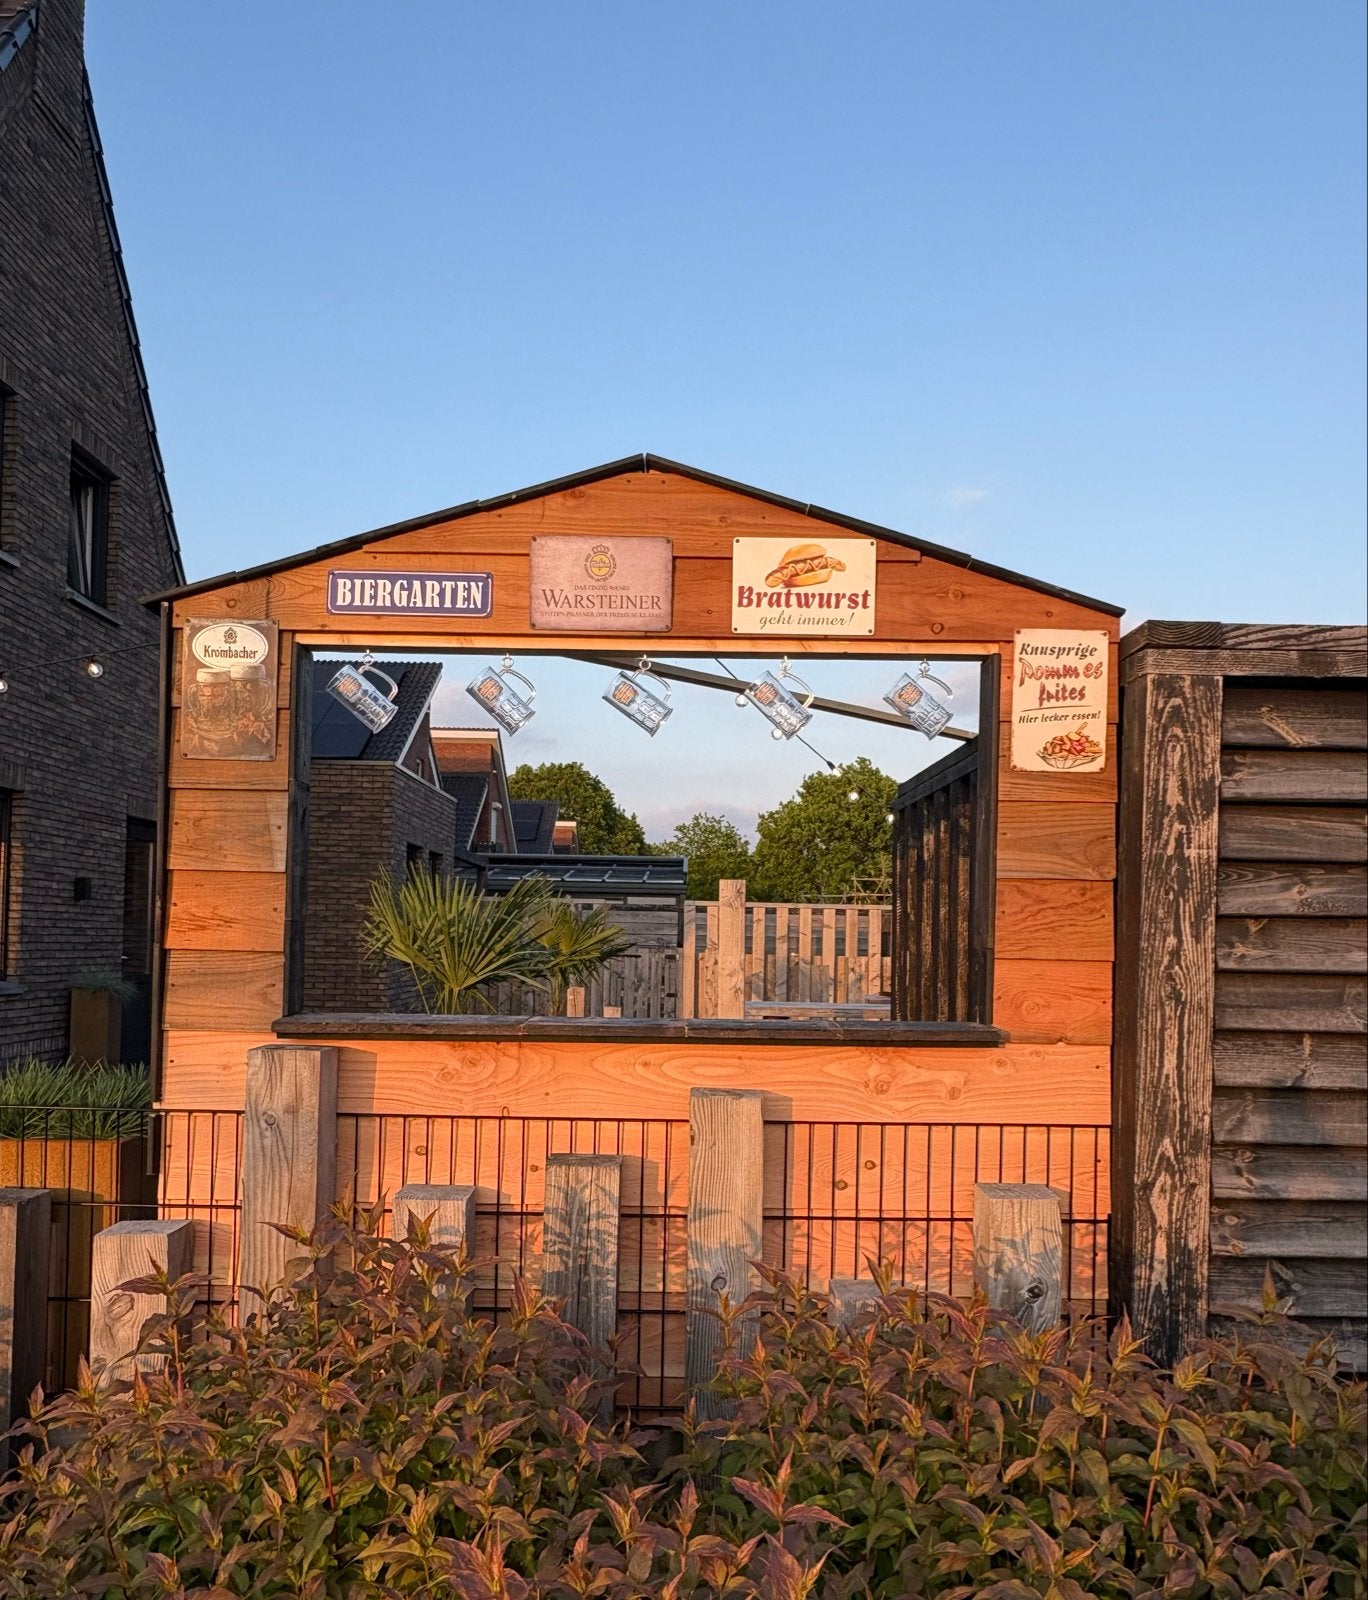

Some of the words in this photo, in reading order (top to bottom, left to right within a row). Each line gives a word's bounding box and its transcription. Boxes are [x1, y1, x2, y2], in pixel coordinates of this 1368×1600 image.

[336, 578, 483, 609] BIERGARTEN
[541, 589, 662, 610] WARSTEINER
[737, 586, 871, 610] Bratwurst
[760, 610, 794, 630] geht
[797, 612, 855, 626] immer!
[203, 645, 259, 660] Krombacher
[1018, 643, 1098, 661] Knusprige
[1018, 657, 1104, 687] Pommes
[1038, 681, 1086, 707] frites
[1018, 714, 1039, 724] Hier
[1040, 713, 1069, 722] lecker
[1071, 710, 1102, 721] essen!
